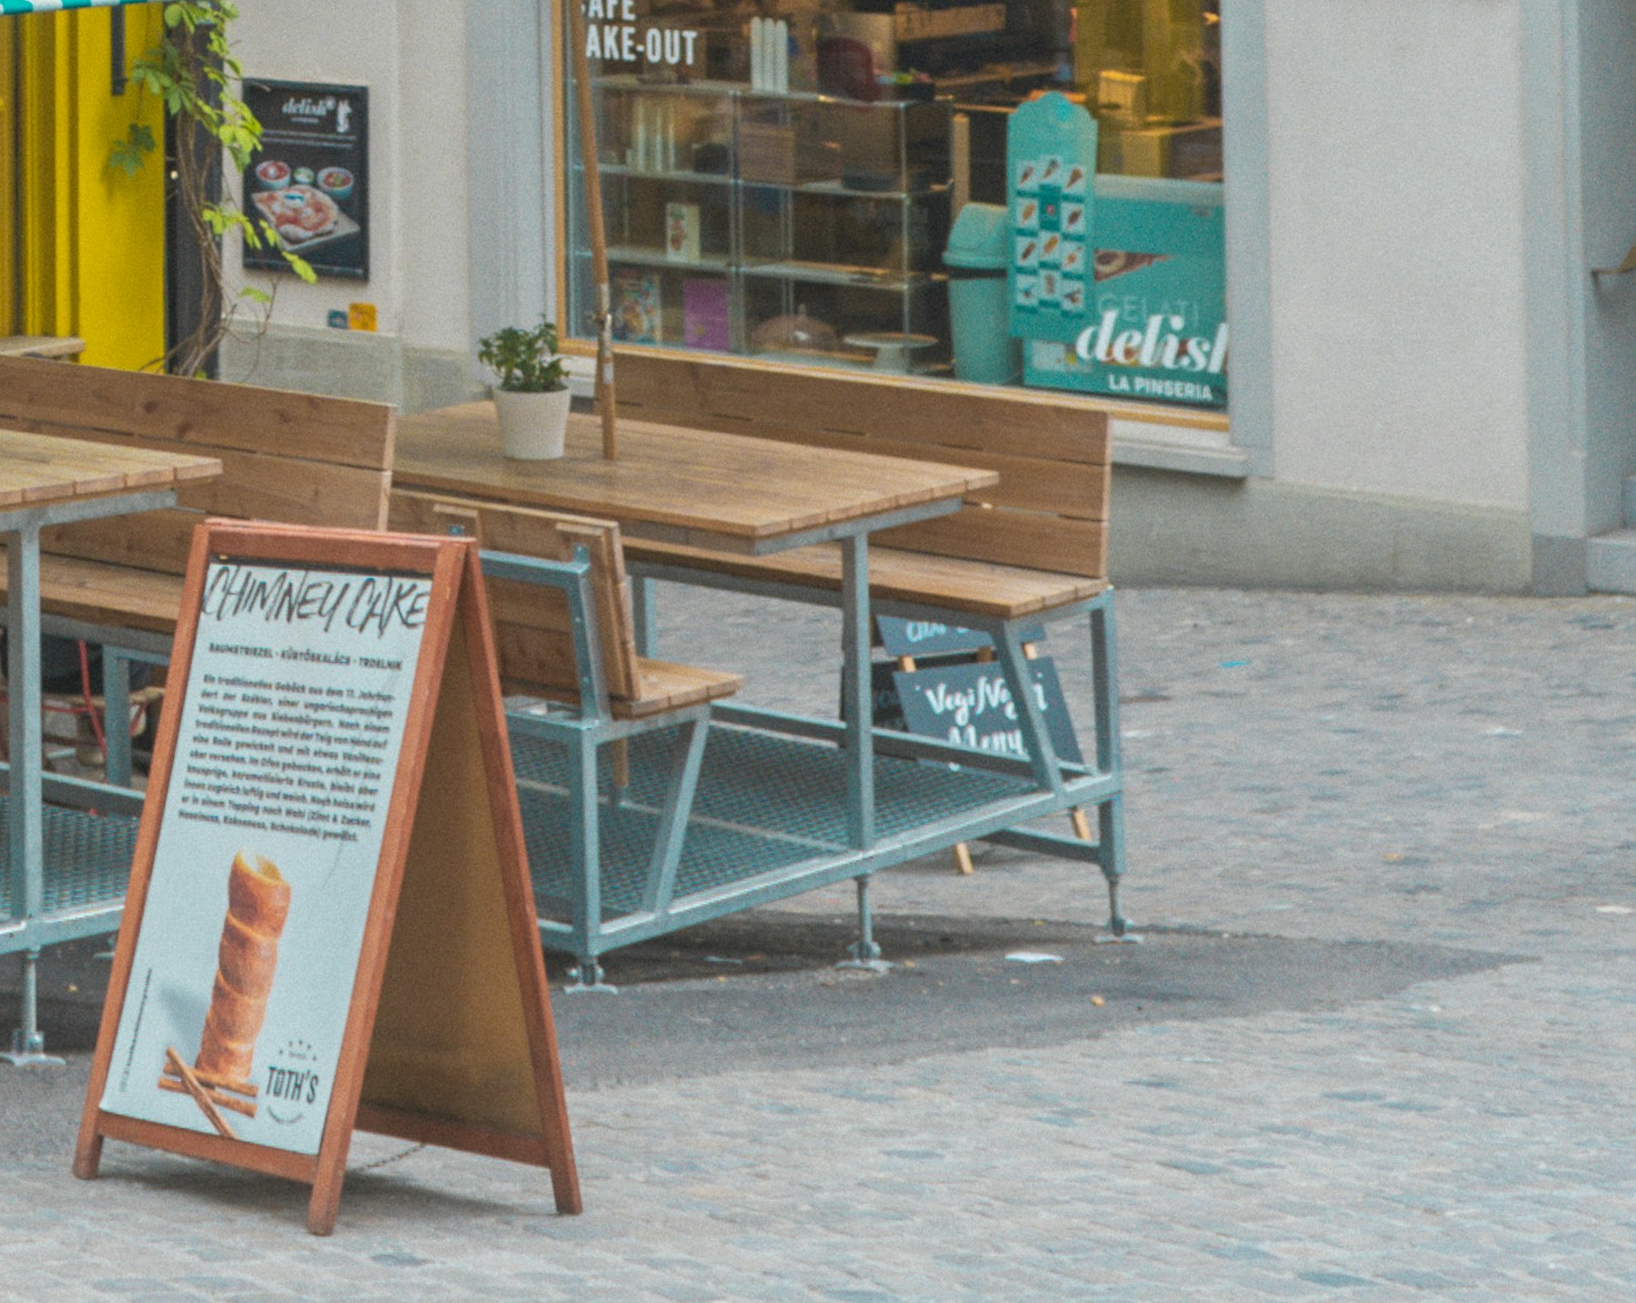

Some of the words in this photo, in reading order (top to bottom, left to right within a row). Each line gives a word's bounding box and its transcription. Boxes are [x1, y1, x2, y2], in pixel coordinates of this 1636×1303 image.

[586, 24, 698, 66] AKE-OUT
[1109, 373, 1131, 391] LA
[201, 564, 350, 633] CHIMNEY
[346, 576, 428, 639] CAKE
